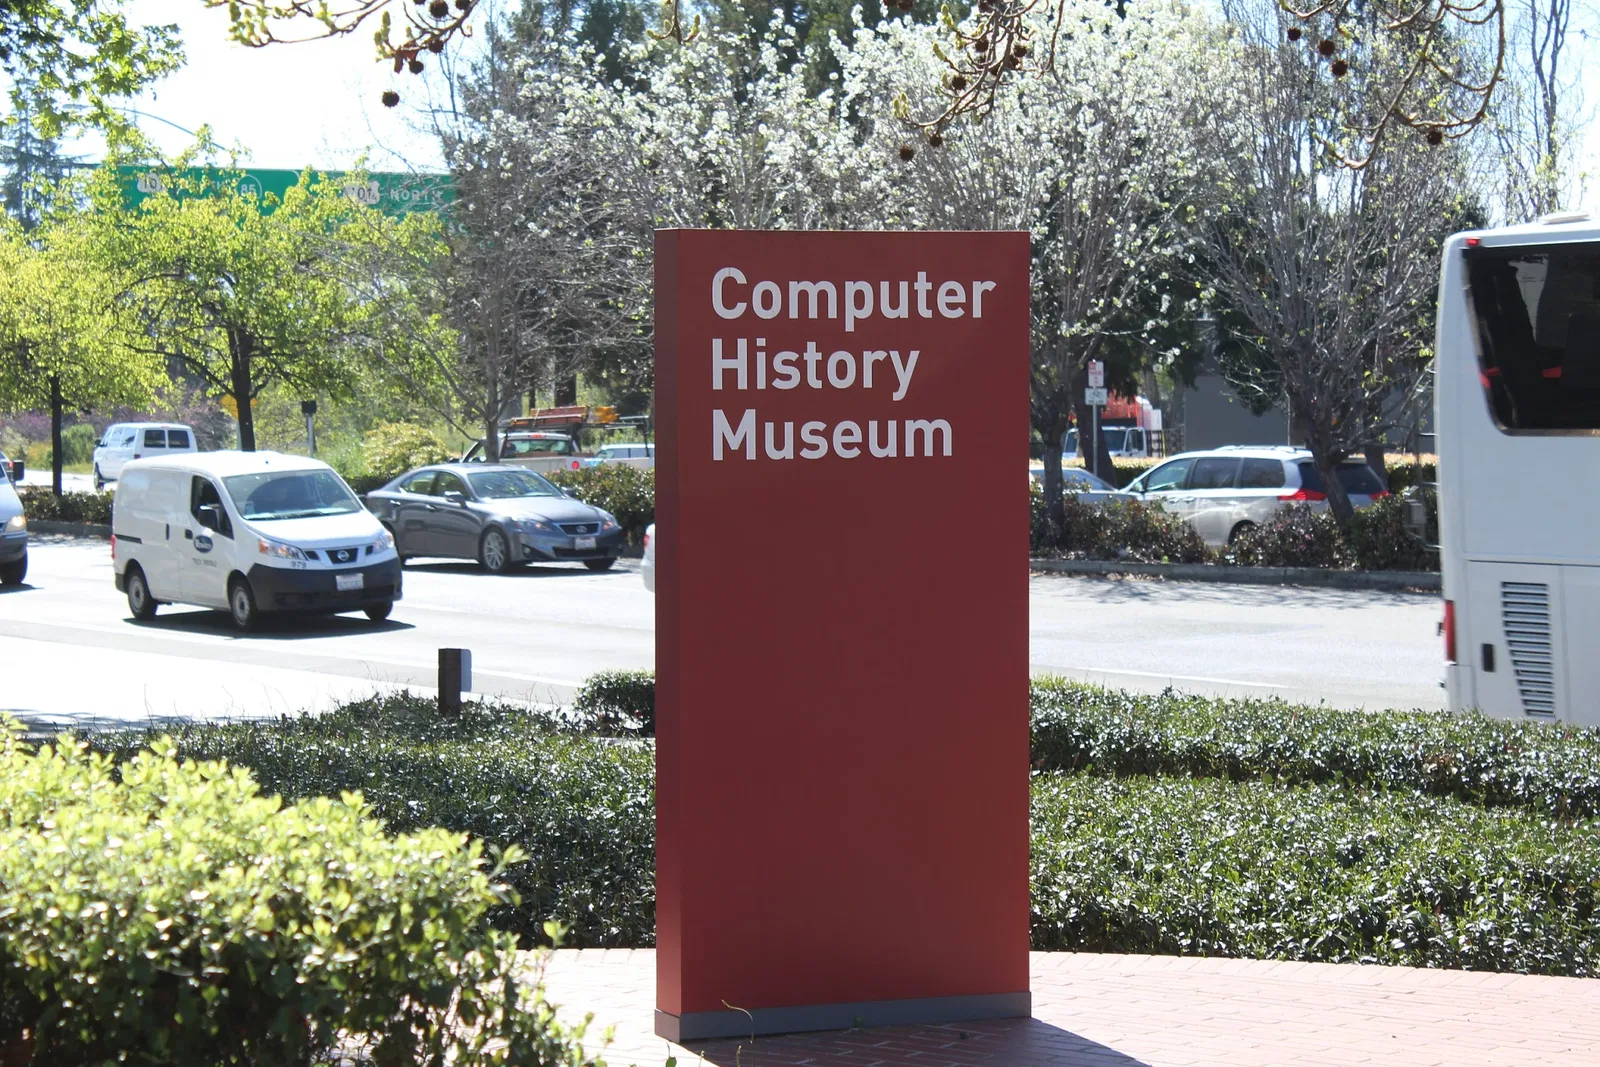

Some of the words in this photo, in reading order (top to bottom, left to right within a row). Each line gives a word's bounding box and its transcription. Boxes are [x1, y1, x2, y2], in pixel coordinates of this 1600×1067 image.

[711, 266, 997, 333] Computer
[712, 337, 921, 402] History
[712, 408, 953, 461] Museum
